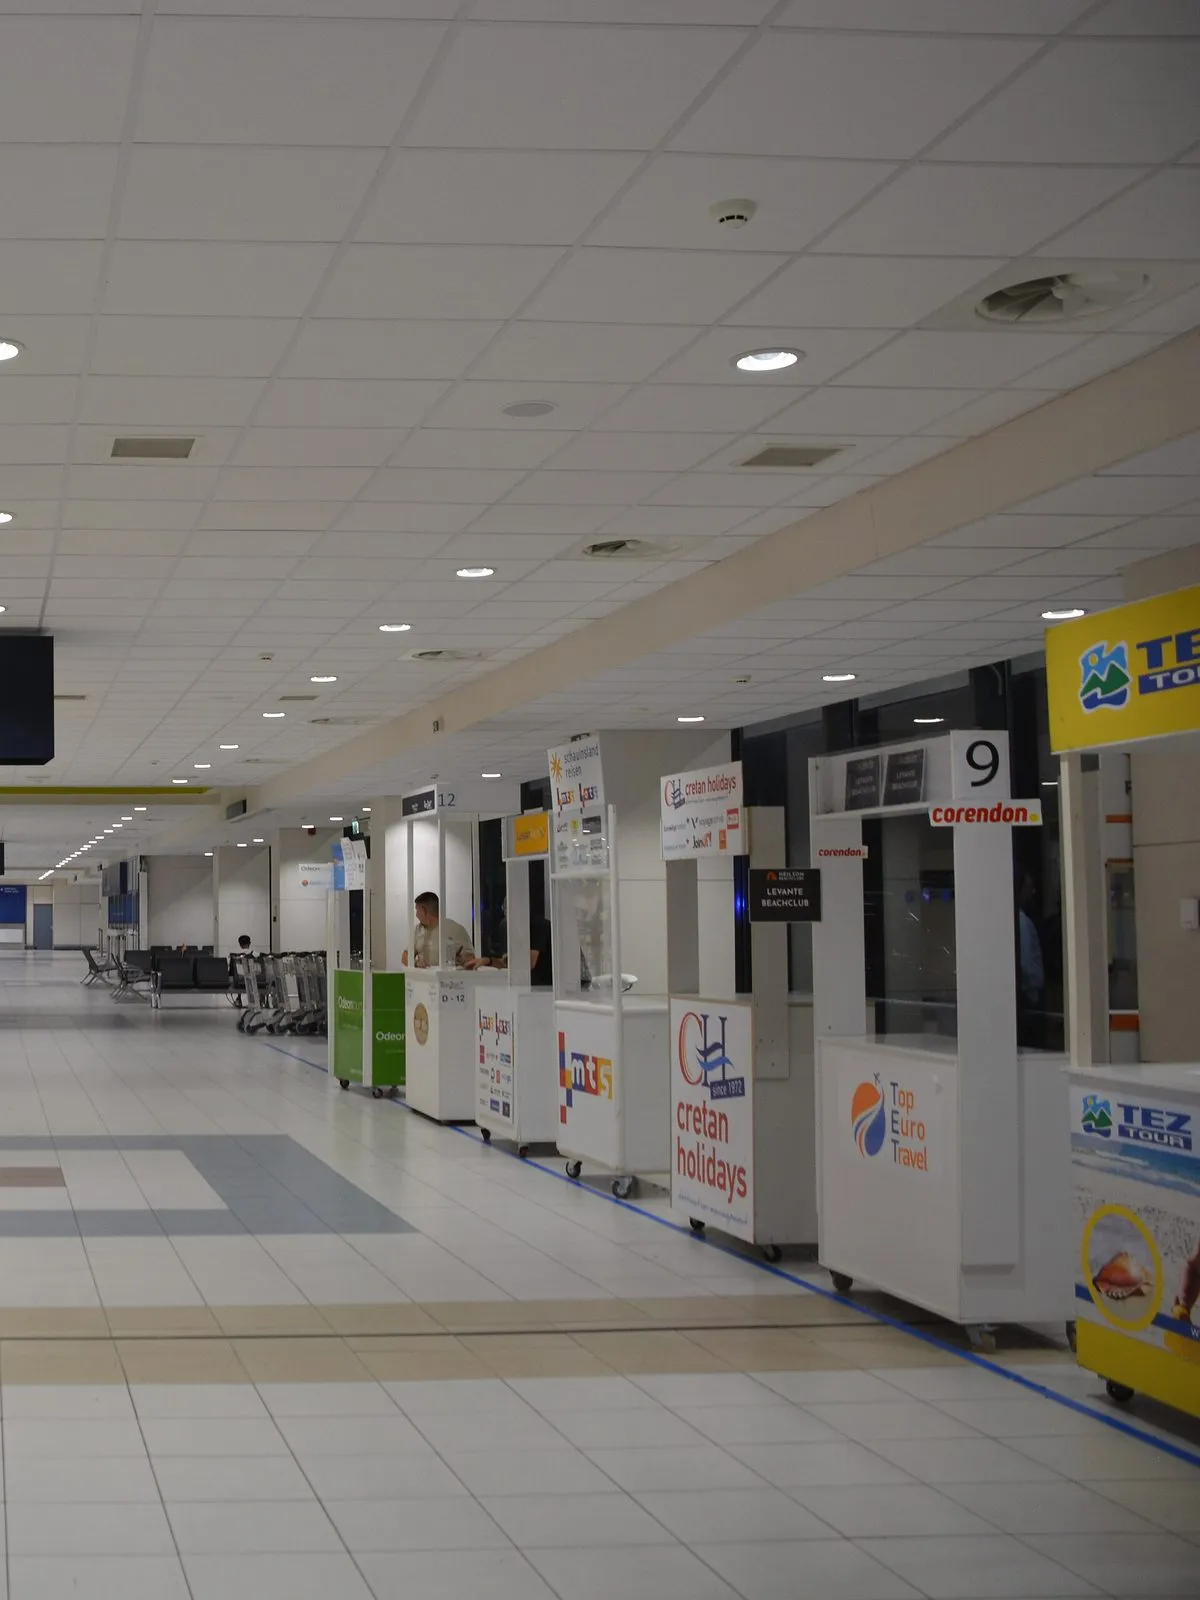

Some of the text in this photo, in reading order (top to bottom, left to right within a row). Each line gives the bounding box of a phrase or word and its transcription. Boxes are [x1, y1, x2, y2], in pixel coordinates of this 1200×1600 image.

[1149, 668, 1200, 689] TO
[965, 740, 999, 787] 9
[685, 774, 737, 796] cretan holidays
[438, 793, 456, 807] 12
[932, 801, 1028, 823] corendon
[818, 847, 862, 857] corendon
[766, 887, 804, 896] LEVANTE
[761, 899, 809, 908] BEACHCLUB
[712, 1080, 743, 1097] since 1972
[890, 1081, 915, 1116] Top
[677, 1100, 728, 1144] cretan
[891, 1109, 926, 1142] Euro
[1117, 1103, 1192, 1135] TEZ
[1127, 1127, 1185, 1148] TOUR
[891, 1138, 929, 1172] Travel
[677, 1136, 748, 1204] holidays
